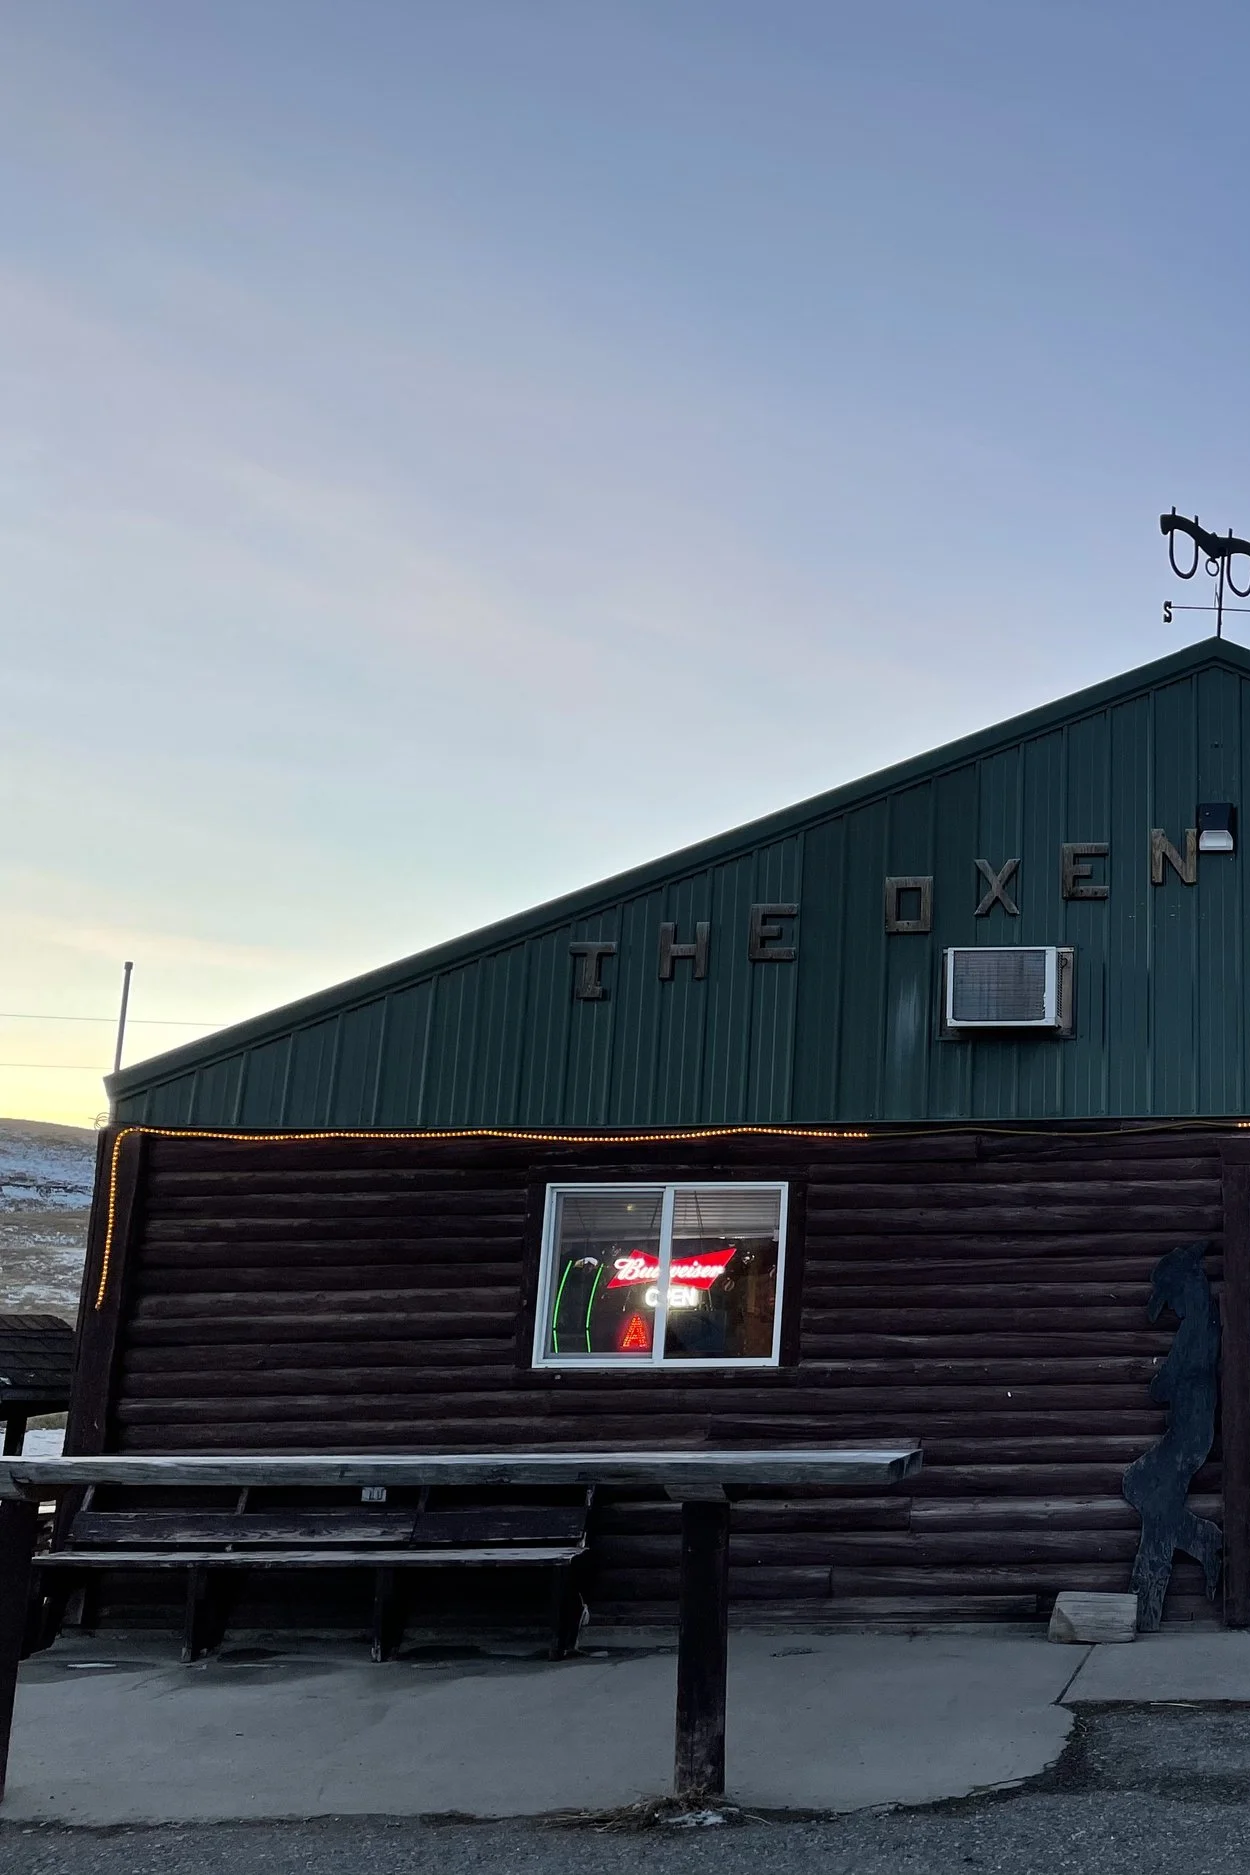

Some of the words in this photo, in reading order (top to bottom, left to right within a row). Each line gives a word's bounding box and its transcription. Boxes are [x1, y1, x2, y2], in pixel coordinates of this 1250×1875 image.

[1163, 600, 1173, 623] S
[569, 903, 799, 1000] THE
[884, 828, 1197, 934] OXEN
[614, 1258, 725, 1280] Buweiser
[645, 1286, 699, 1308] OEN
